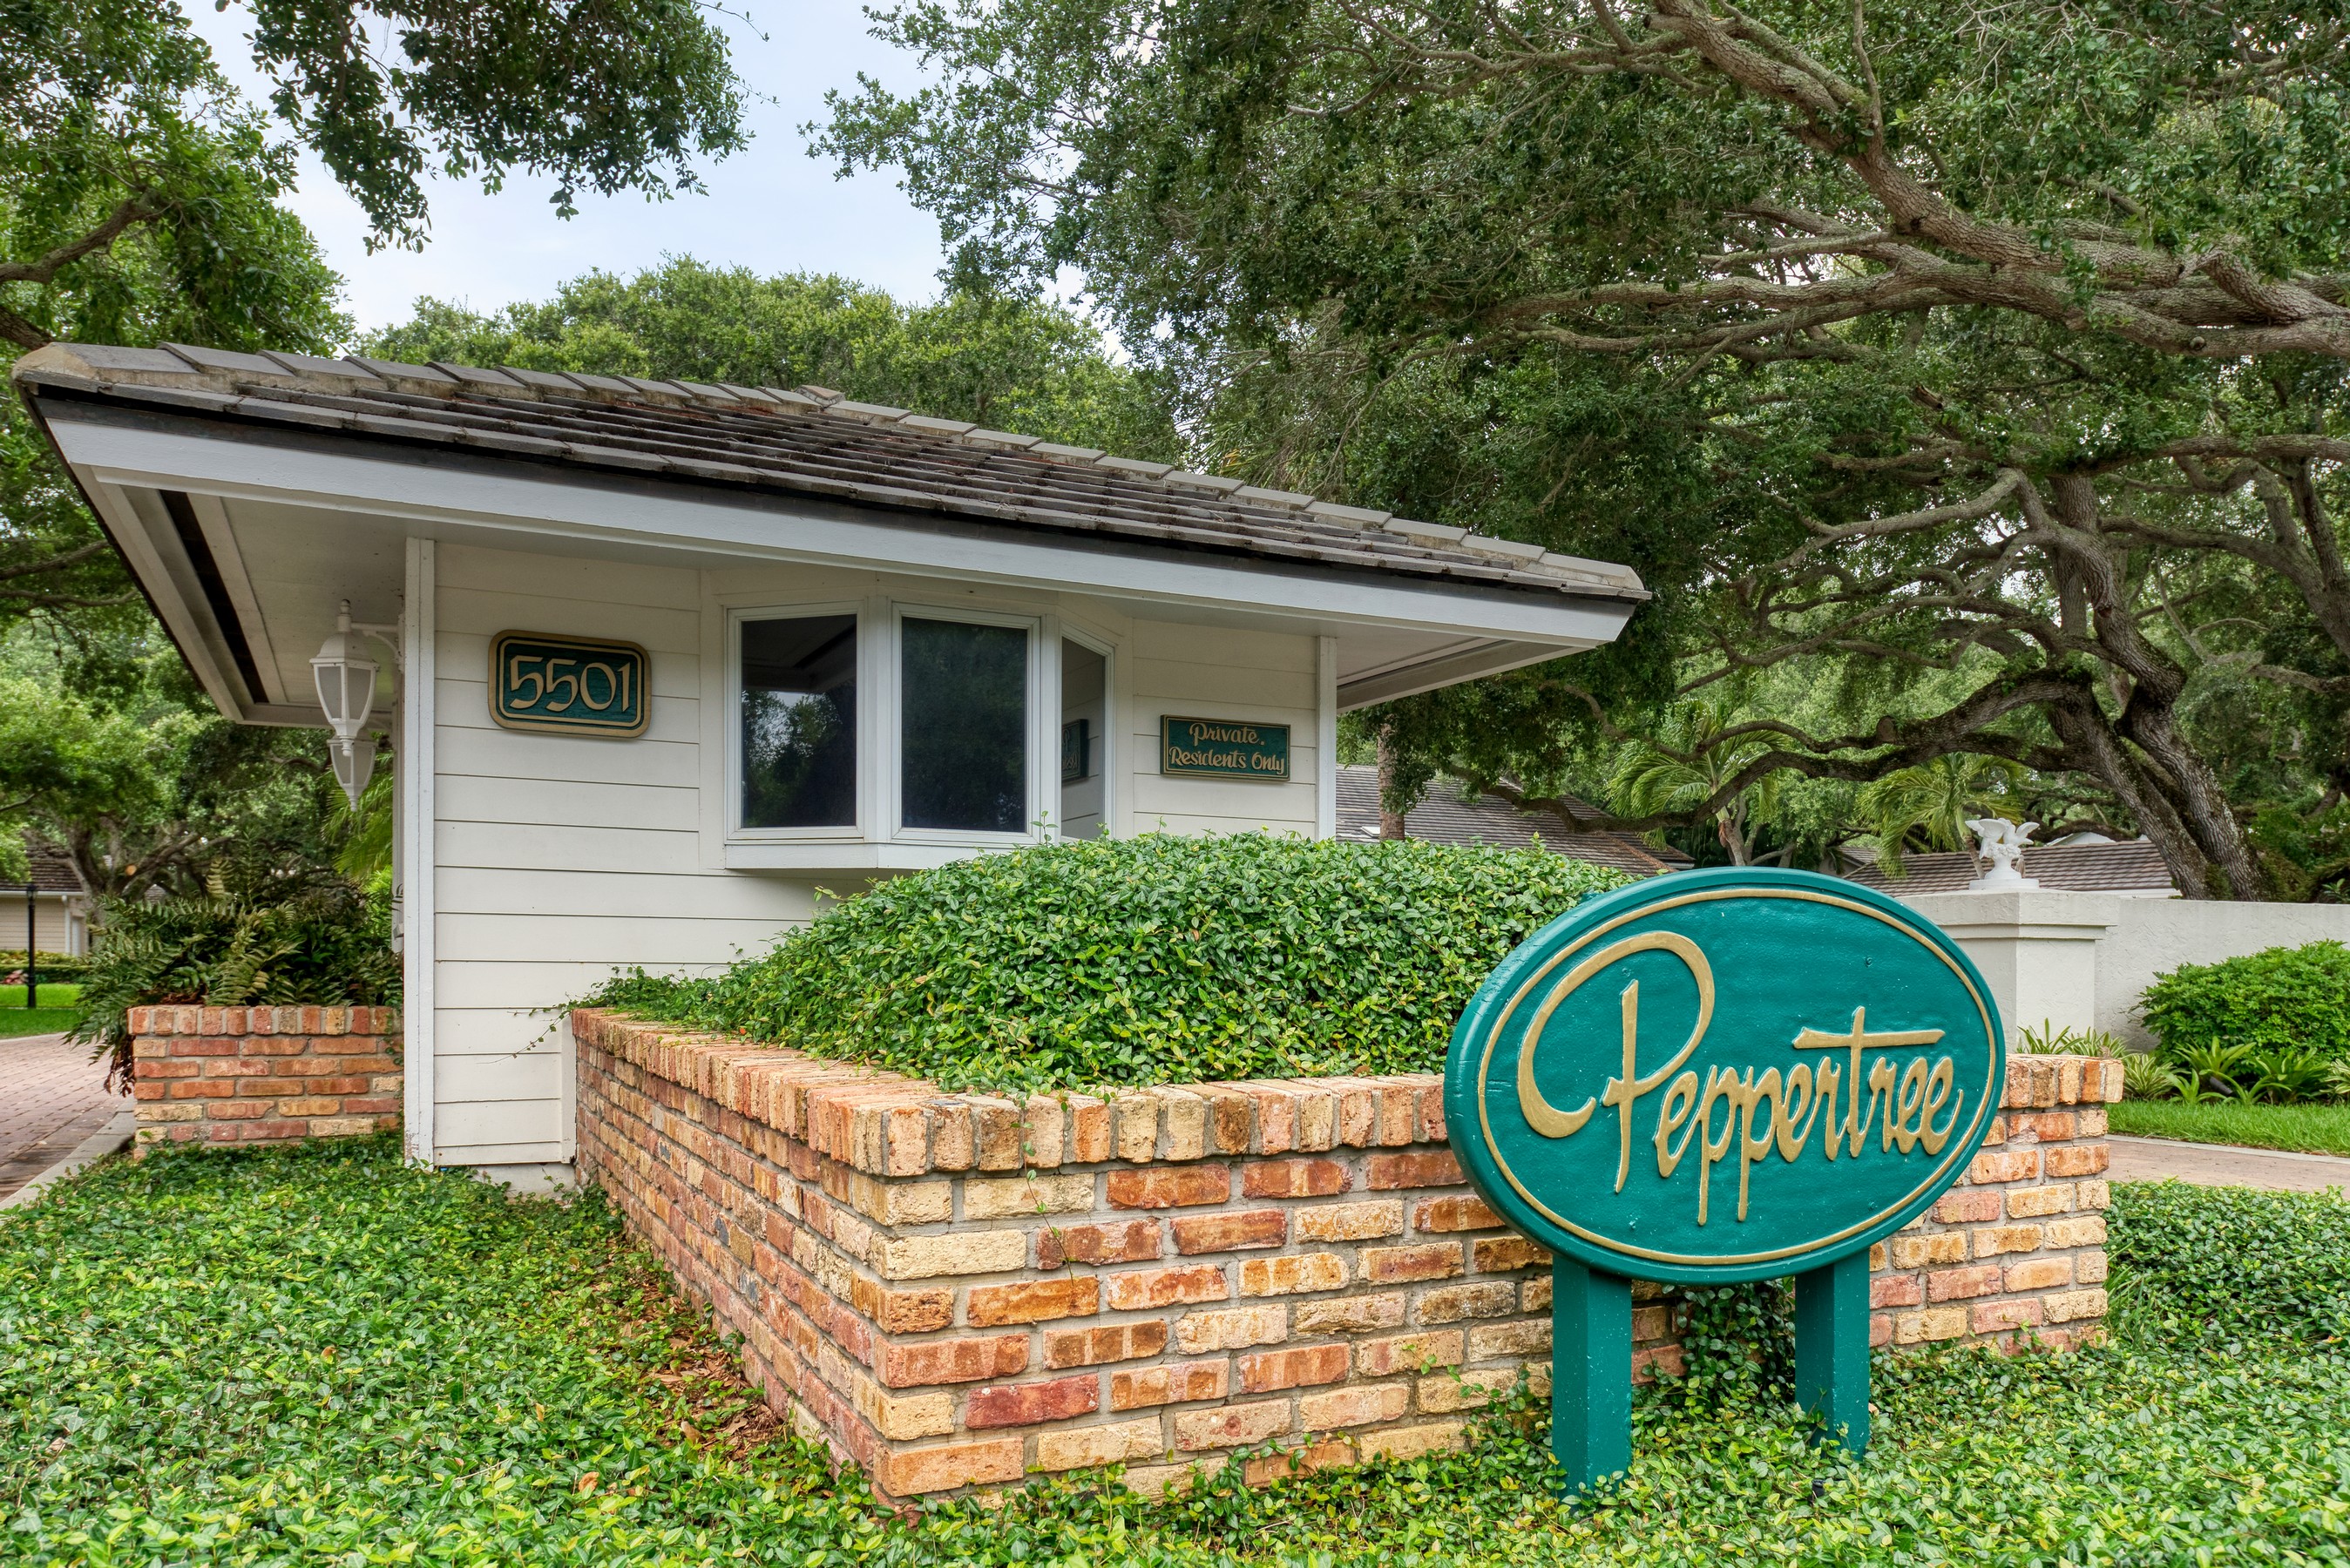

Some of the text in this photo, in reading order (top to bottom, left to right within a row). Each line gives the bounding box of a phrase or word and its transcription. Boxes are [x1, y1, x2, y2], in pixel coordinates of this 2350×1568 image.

[510, 655, 630, 712] 5501
[1169, 747, 1284, 774] Residents Only
[1517, 931, 1964, 1226] Peppertree
